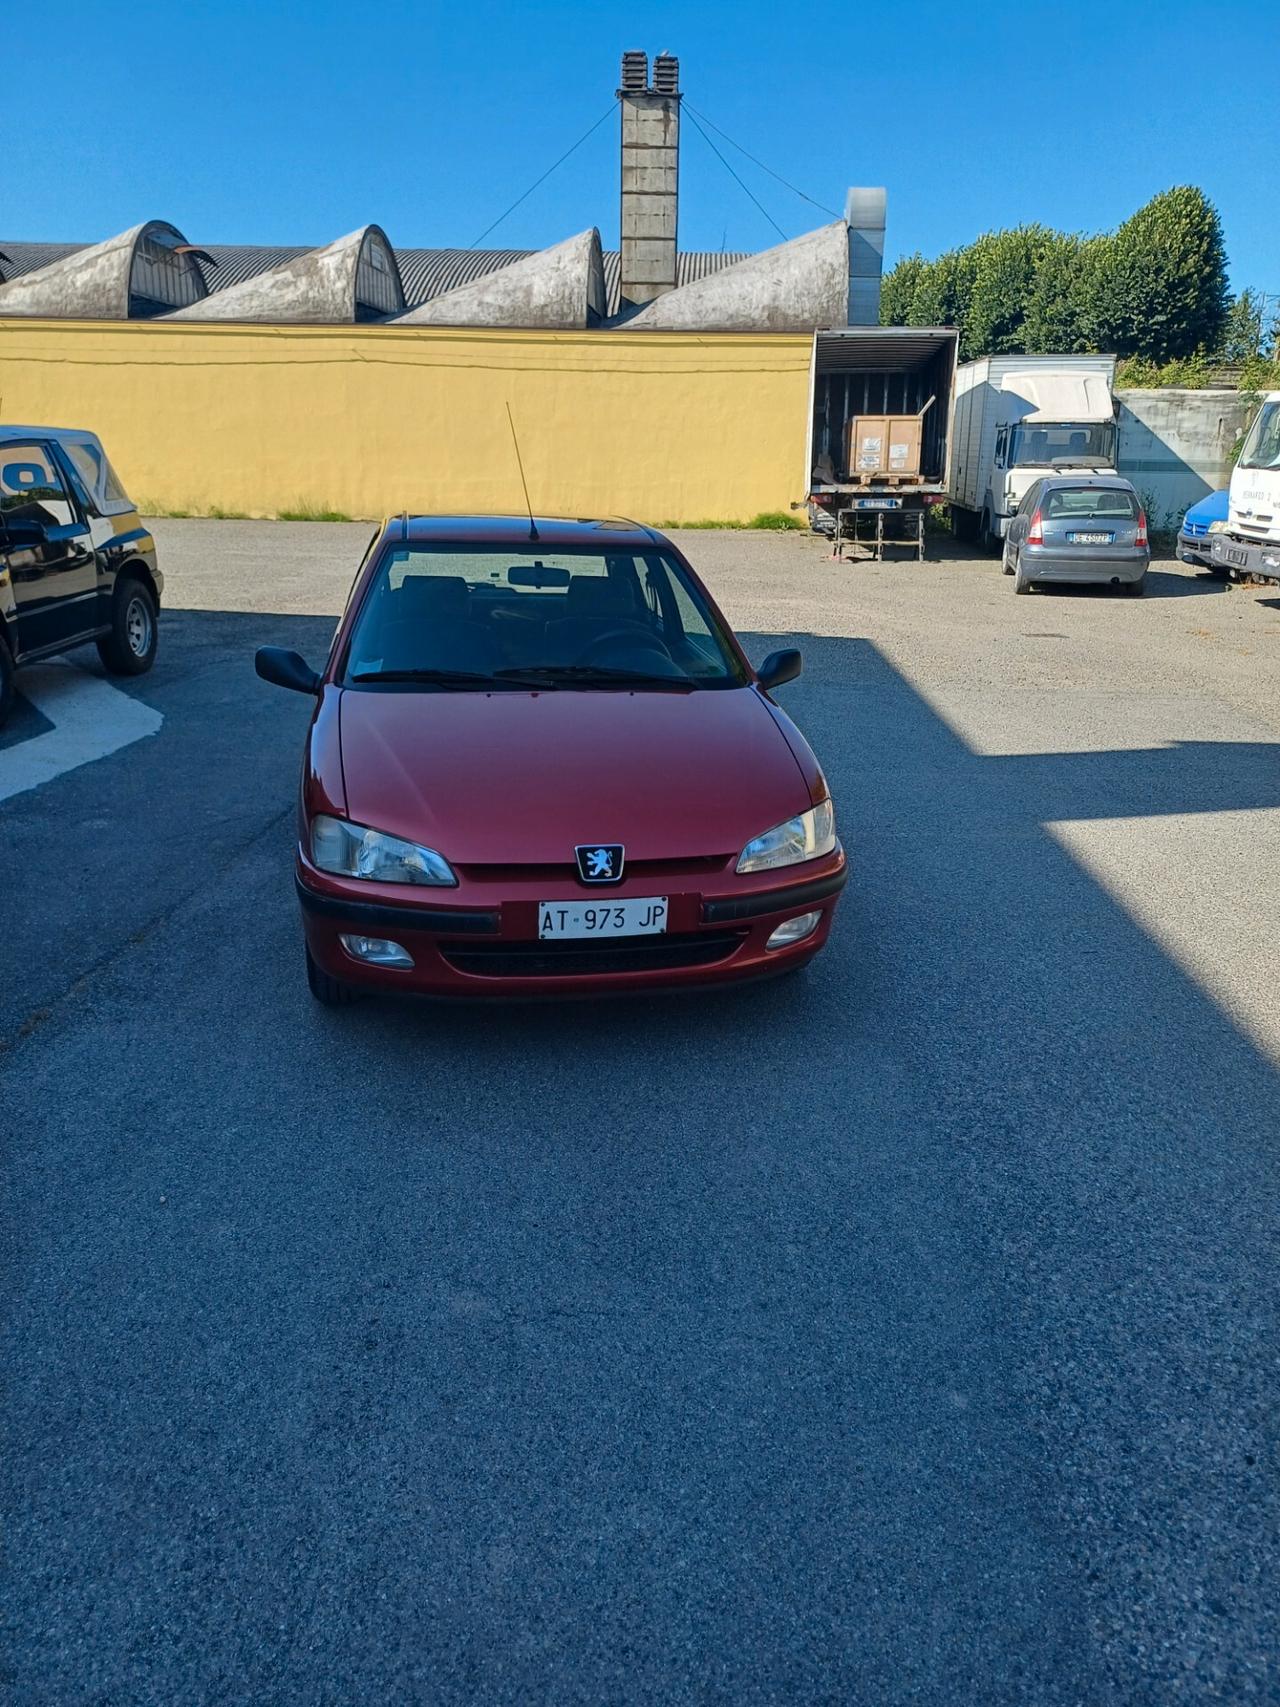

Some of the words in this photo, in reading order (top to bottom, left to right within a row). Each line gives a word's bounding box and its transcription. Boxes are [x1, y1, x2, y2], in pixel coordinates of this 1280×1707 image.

[542, 910, 569, 931] AT
[584, 907, 626, 930] 973
[638, 905, 665, 927] JP
